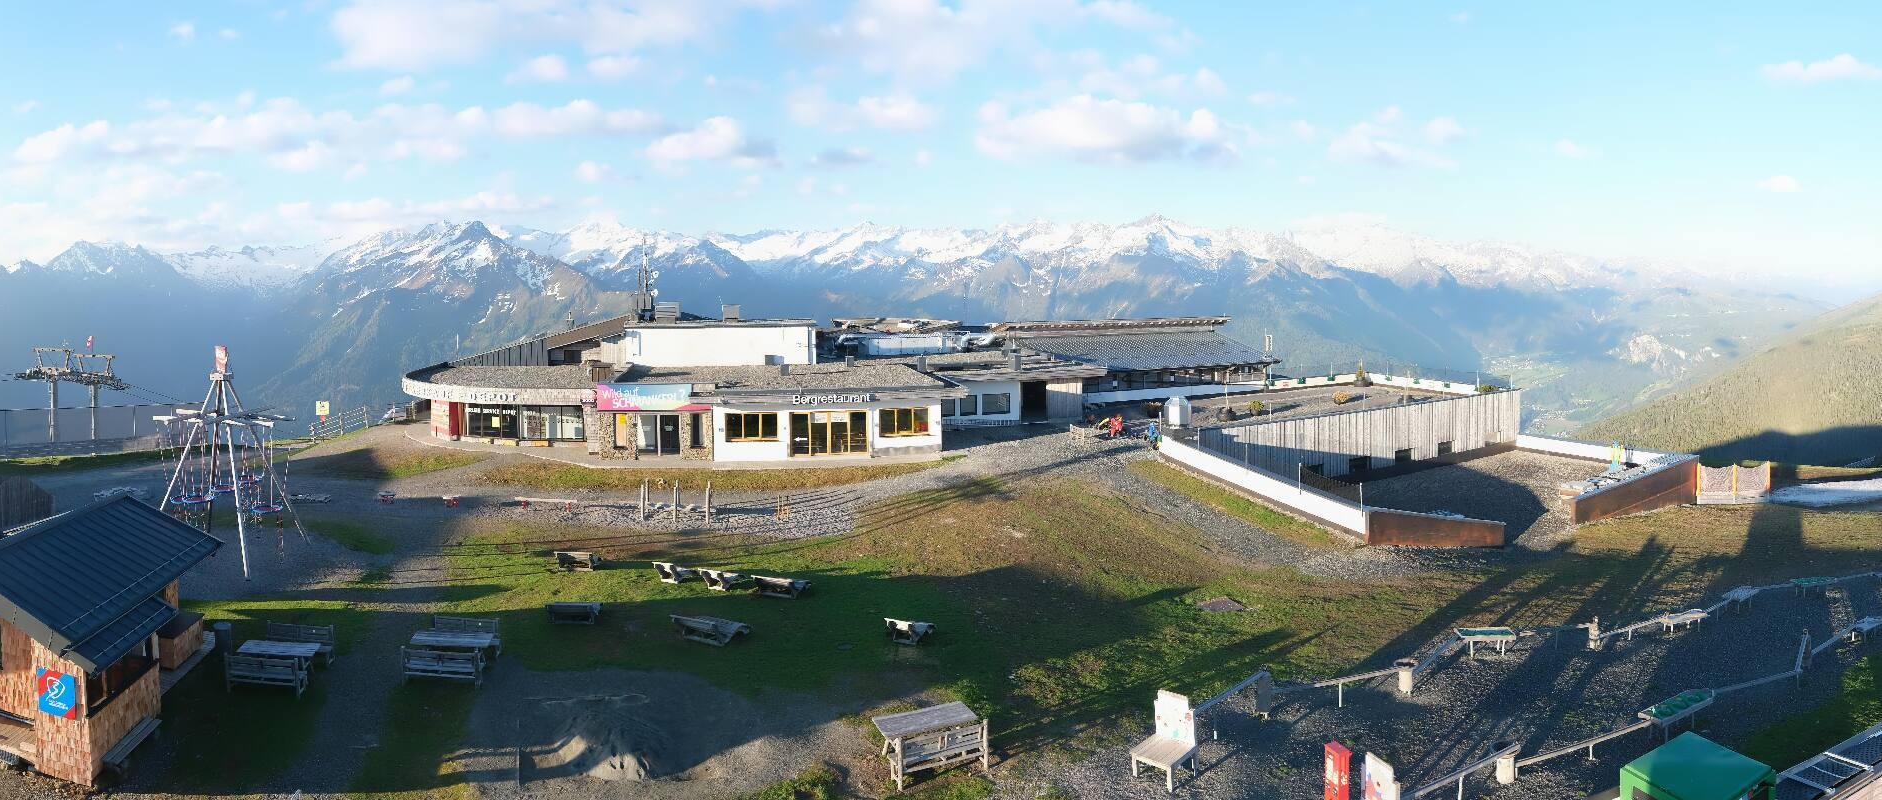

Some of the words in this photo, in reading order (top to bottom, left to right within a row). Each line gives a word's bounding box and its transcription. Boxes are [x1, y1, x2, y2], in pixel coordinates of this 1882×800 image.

[602, 388, 622, 399] Wild
[623, 387, 640, 397] auf
[793, 393, 871, 406] Bergrestaurant
